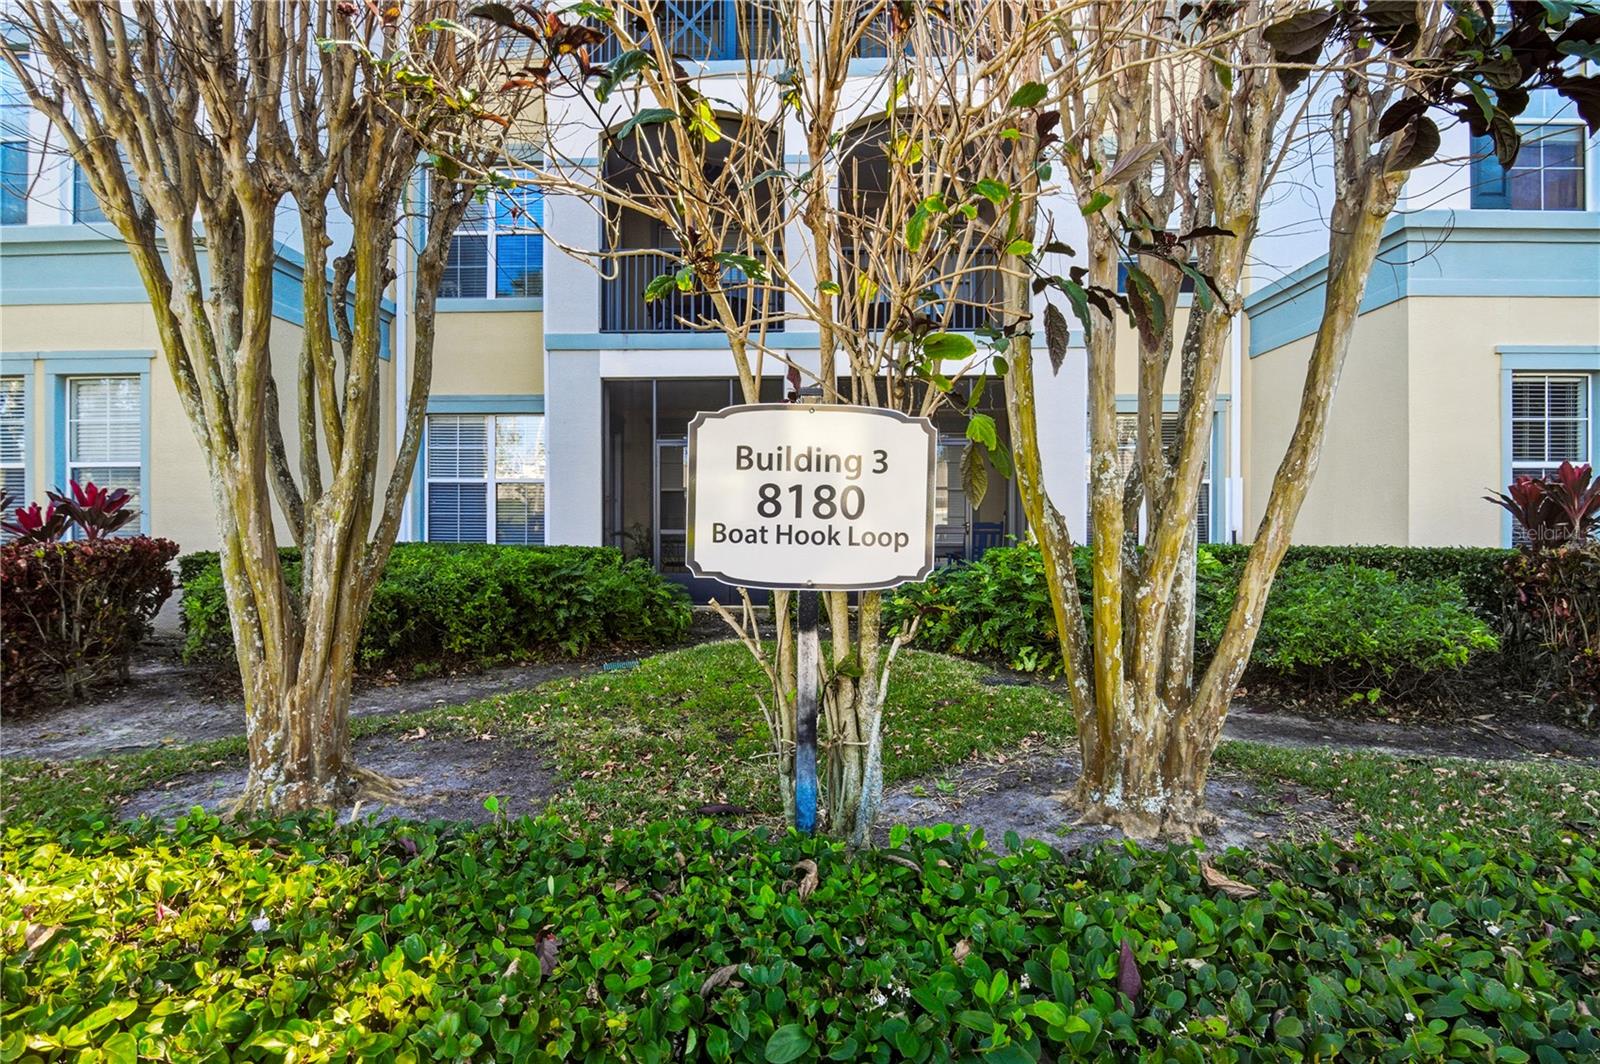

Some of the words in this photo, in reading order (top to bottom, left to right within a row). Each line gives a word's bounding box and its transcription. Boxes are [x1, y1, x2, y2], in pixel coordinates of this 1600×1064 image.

[736, 445, 863, 480] Building
[872, 449, 889, 474] 3
[756, 483, 866, 520] 8180
[712, 522, 769, 545] Boat
[776, 524, 841, 546] Hook
[848, 526, 909, 553] Loop
